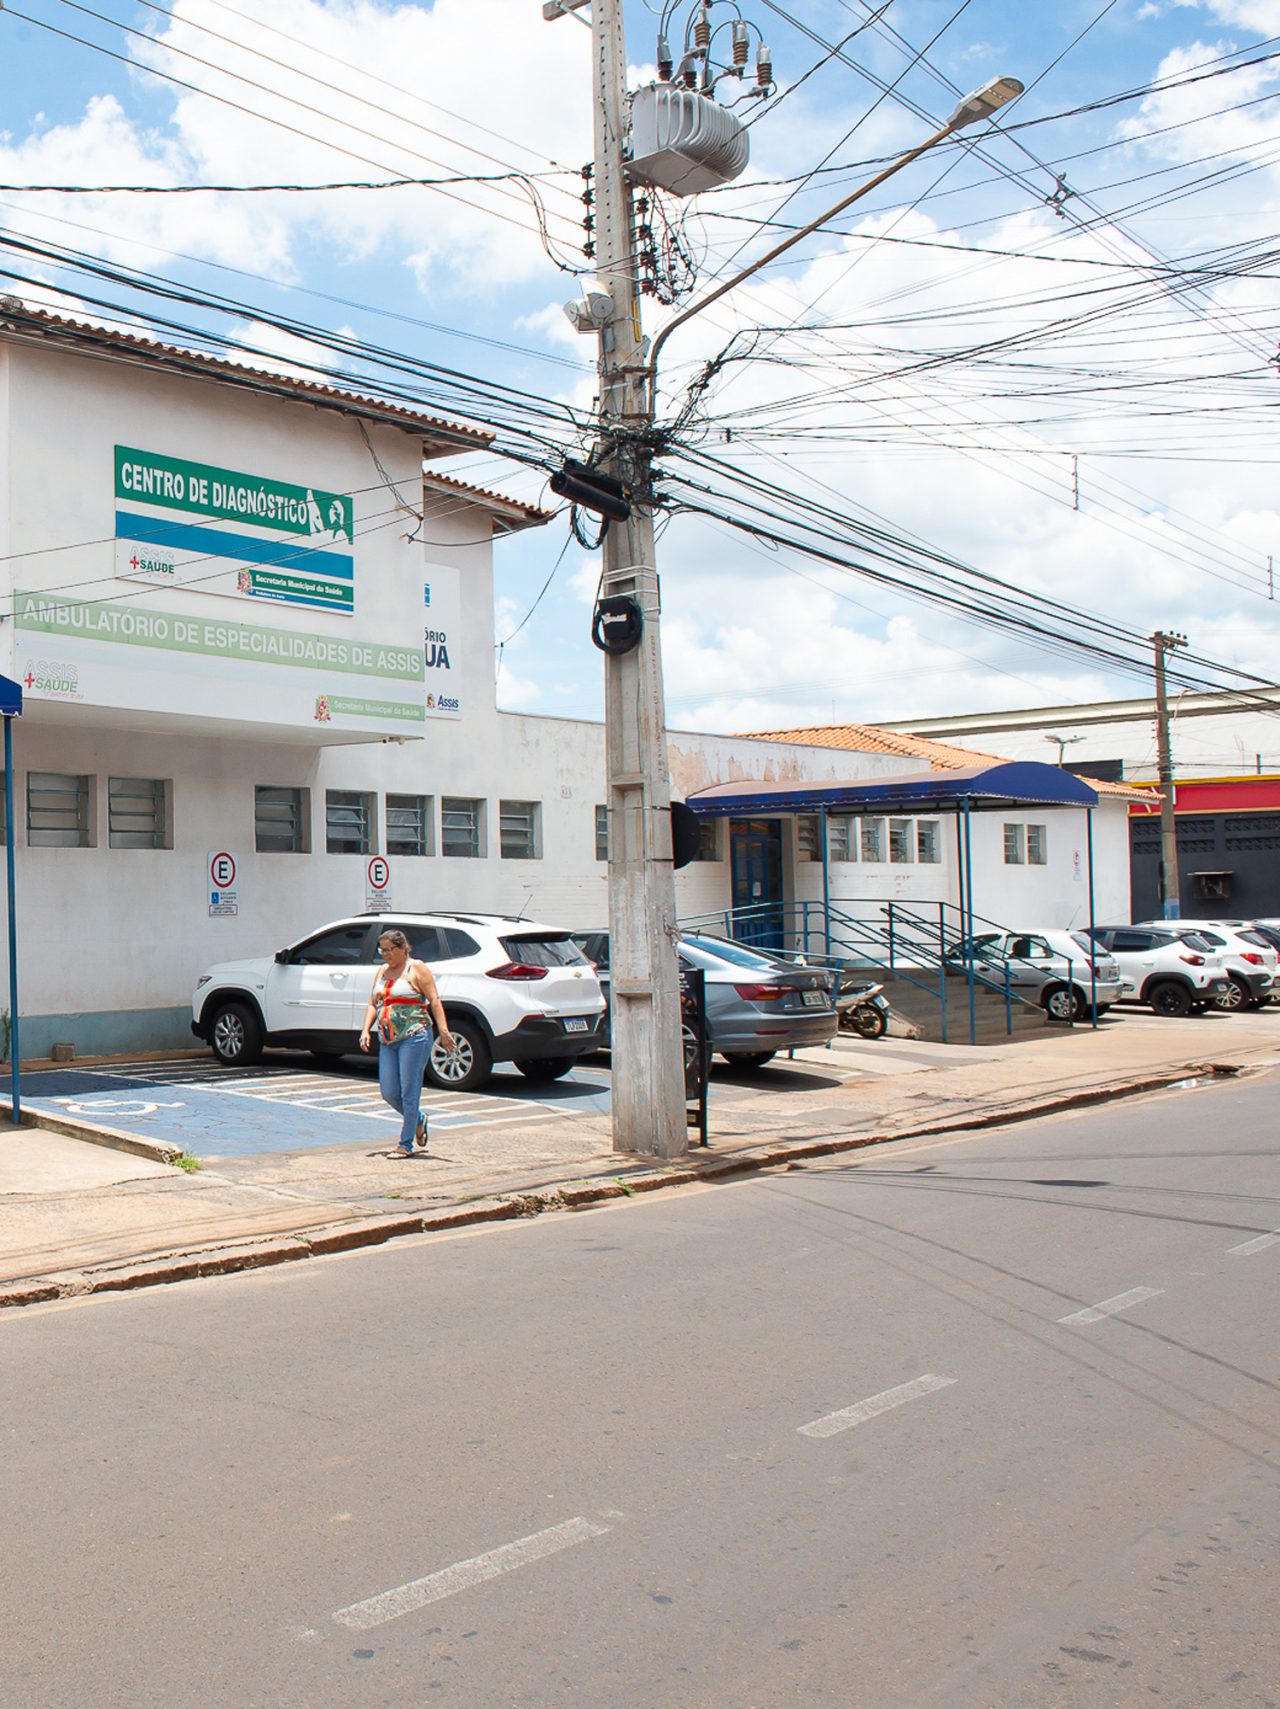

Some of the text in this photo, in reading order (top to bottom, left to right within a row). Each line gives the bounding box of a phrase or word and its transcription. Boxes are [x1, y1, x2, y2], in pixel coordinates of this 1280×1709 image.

[122, 462, 307, 525] CENTRO DE DIAGNÓSTICO
[23, 598, 420, 673] AMBULATÓRIO DE ESPECIALIDADES DE ASSIS
[437, 694, 459, 708] Assis
[219, 861, 228, 879] E
[375, 865, 383, 881] E
